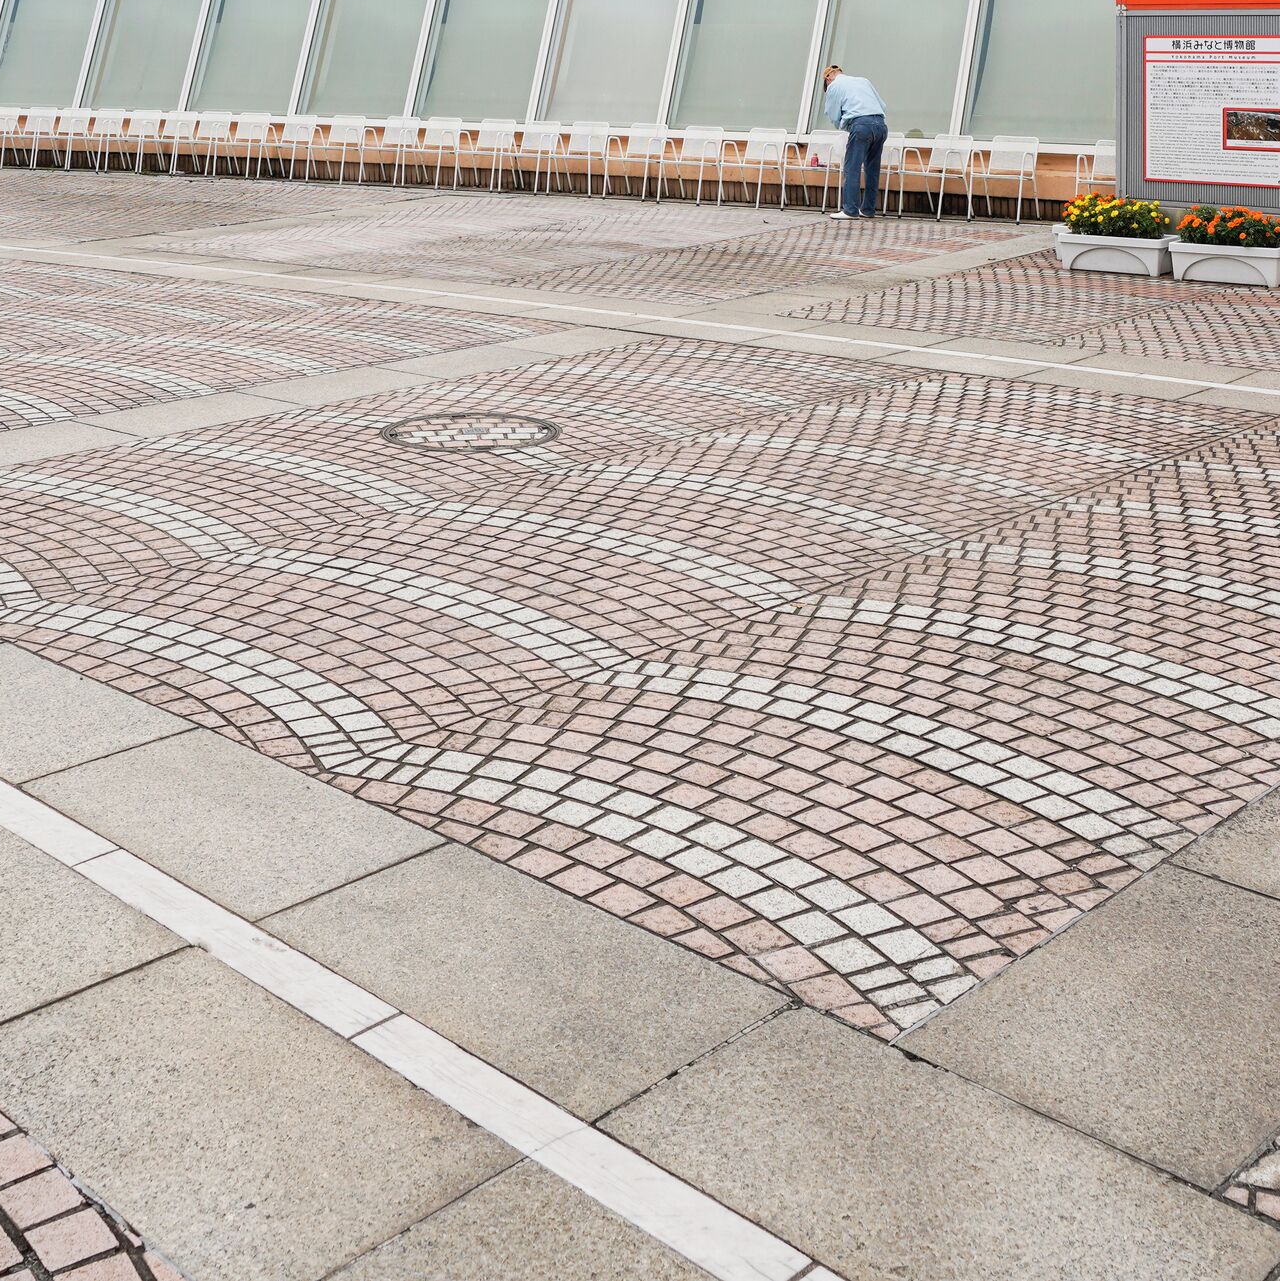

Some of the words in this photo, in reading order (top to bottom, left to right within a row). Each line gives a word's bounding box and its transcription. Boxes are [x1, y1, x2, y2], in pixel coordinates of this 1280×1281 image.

[1171, 39, 1256, 51] 横浜みなと博物館
